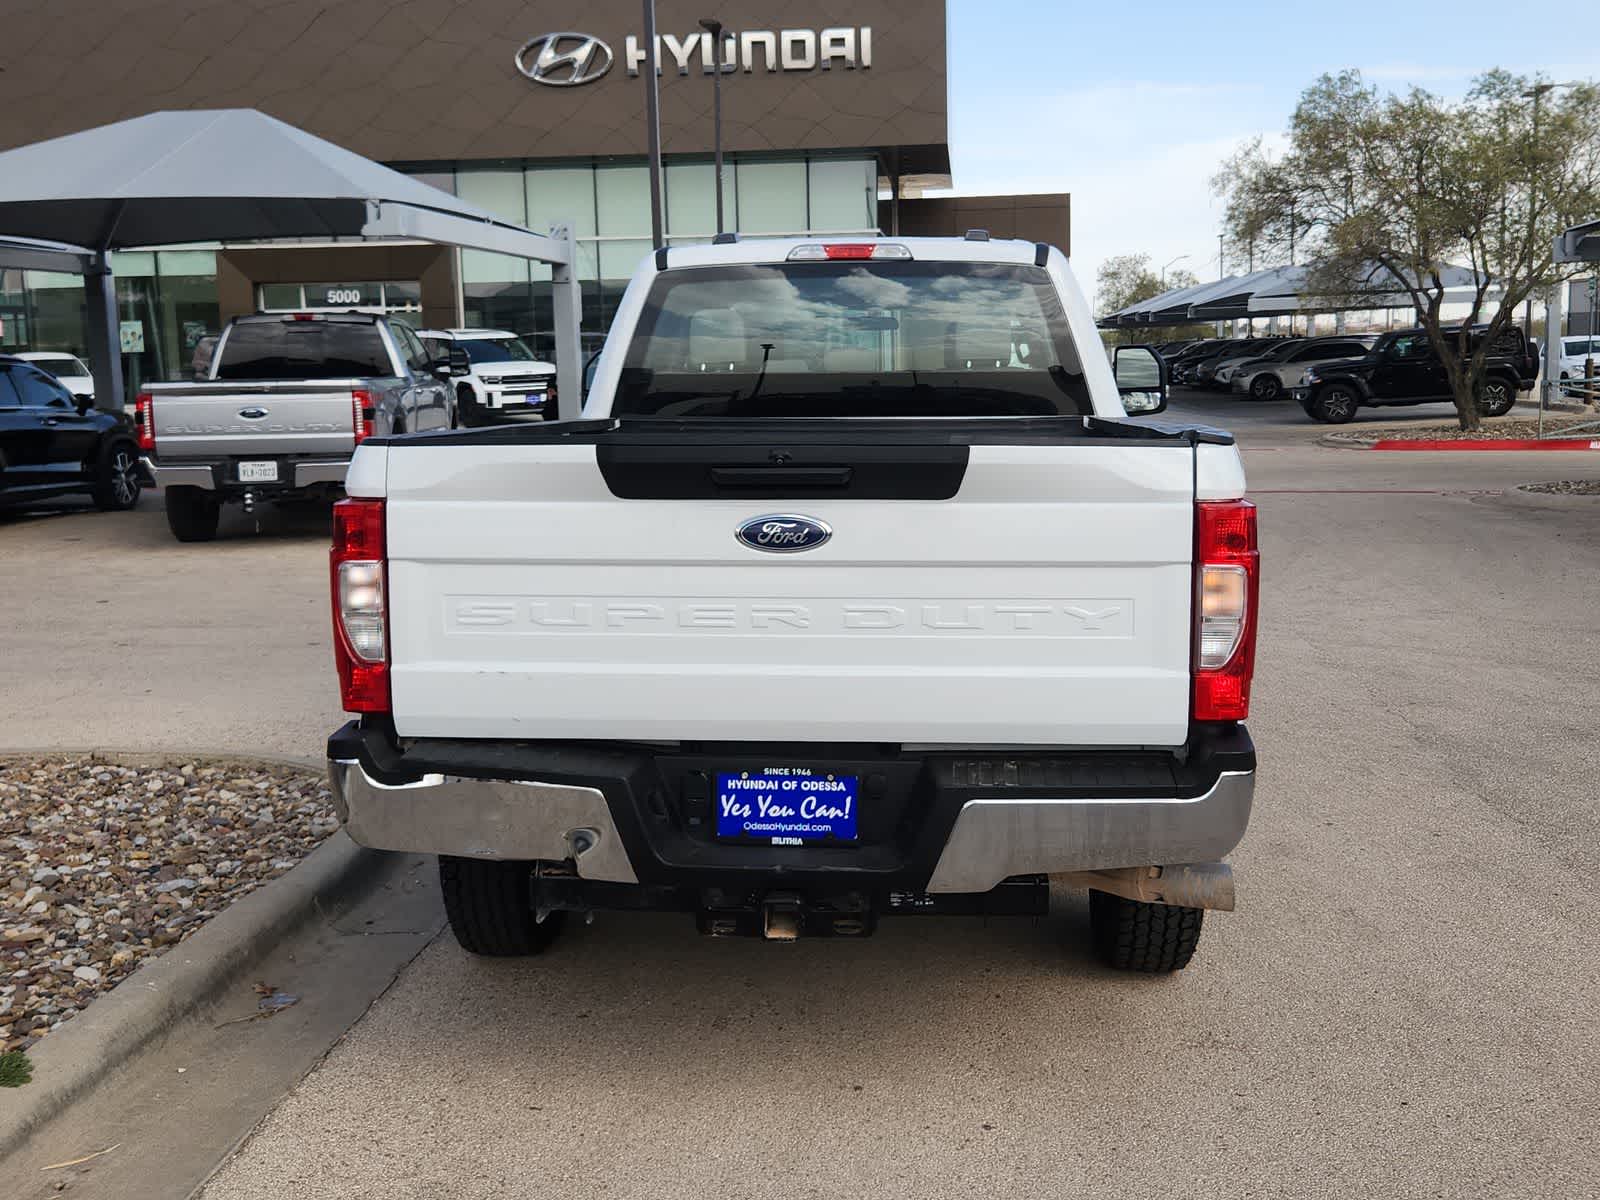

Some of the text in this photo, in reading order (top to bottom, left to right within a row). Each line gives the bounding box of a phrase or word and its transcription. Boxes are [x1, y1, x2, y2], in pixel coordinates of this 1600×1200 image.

[625, 26, 872, 77] HYUNDAI
[327, 290, 360, 303] 5000
[757, 522, 809, 544] Ford
[456, 601, 1121, 630] SUPER DUTY
[763, 767, 790, 776] SINCE
[728, 780, 846, 792] HYUNDAI OF ODESSA
[720, 794, 852, 819] Yes You Can!
[743, 821, 832, 832] OdessaHyundai.com
